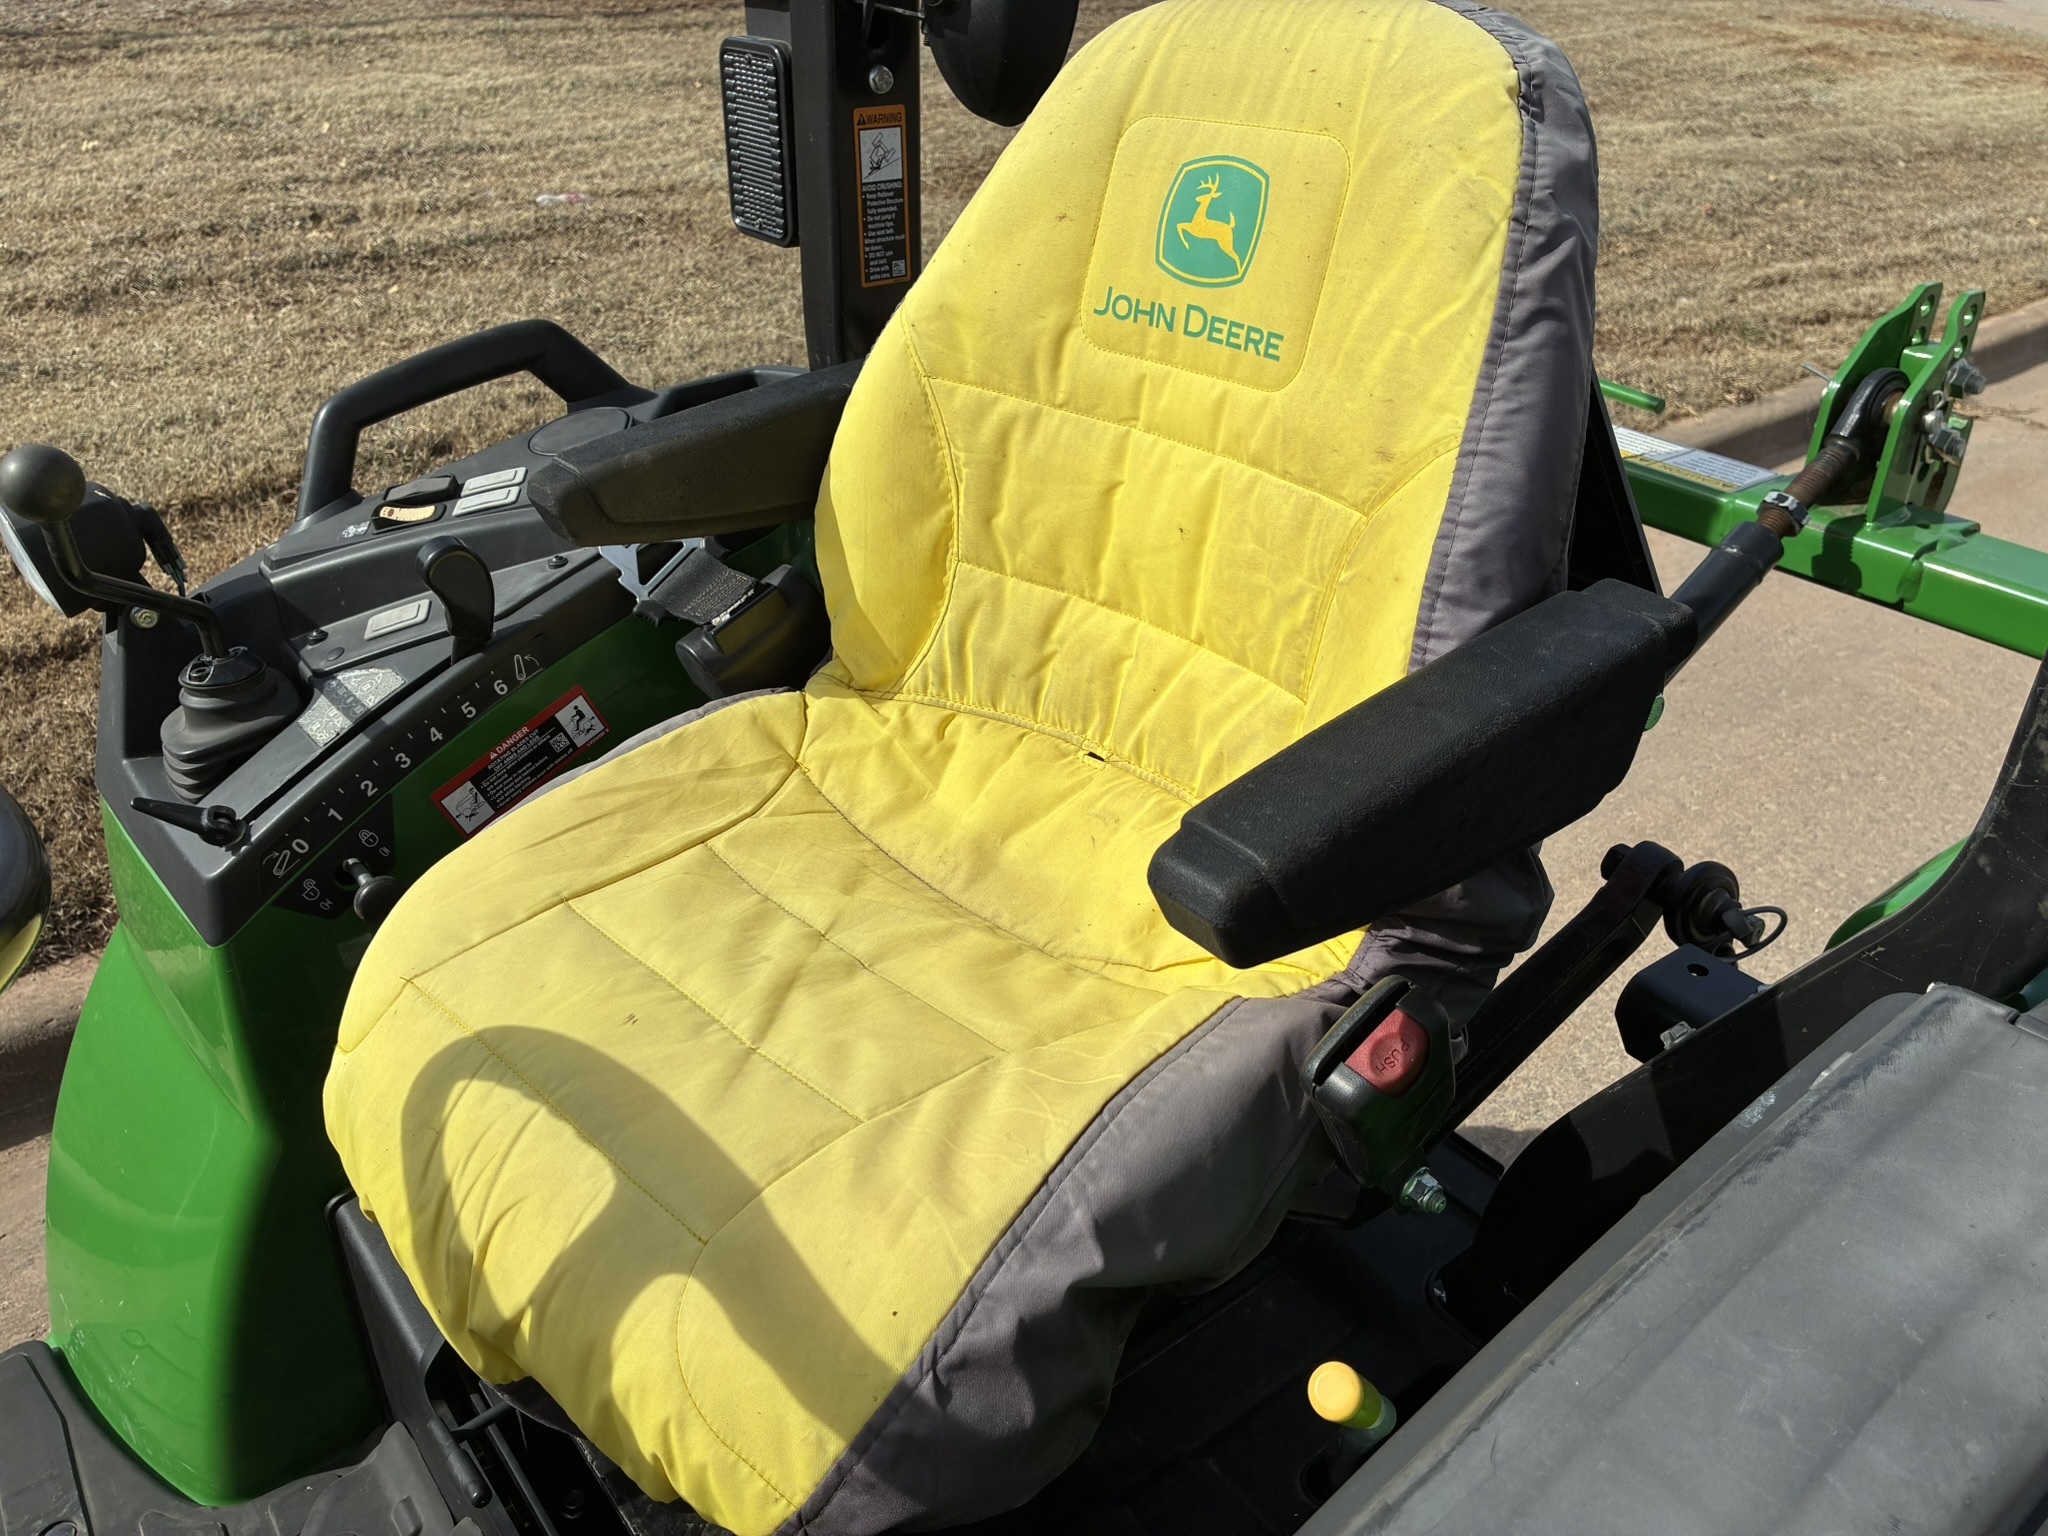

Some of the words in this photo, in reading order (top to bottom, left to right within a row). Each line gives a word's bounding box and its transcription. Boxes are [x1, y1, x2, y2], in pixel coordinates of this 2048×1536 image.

[865, 112, 902, 125] WARNING
[862, 183, 876, 192] AVOID
[1093, 286, 1177, 332] JOHN
[1183, 303, 1285, 362] DEERE
[487, 749, 511, 770] ROTATING
[510, 735, 530, 752] BLADES
[528, 728, 539, 738] CUT
[493, 761, 504, 771] OFF
[502, 751, 517, 764] ARMS
[516, 743, 527, 754] AND
[526, 734, 540, 746] LEGS
[495, 725, 530, 754] DANGER
[516, 747, 533, 761] children
[291, 838, 309, 853] 0
[328, 808, 343, 821] 1
[360, 780, 378, 797] 2
[395, 753, 411, 769] 3
[429, 726, 443, 743] 4
[460, 702, 477, 718] 5
[493, 679, 508, 695] 6
[1375, 1038, 1410, 1075] PUSH
